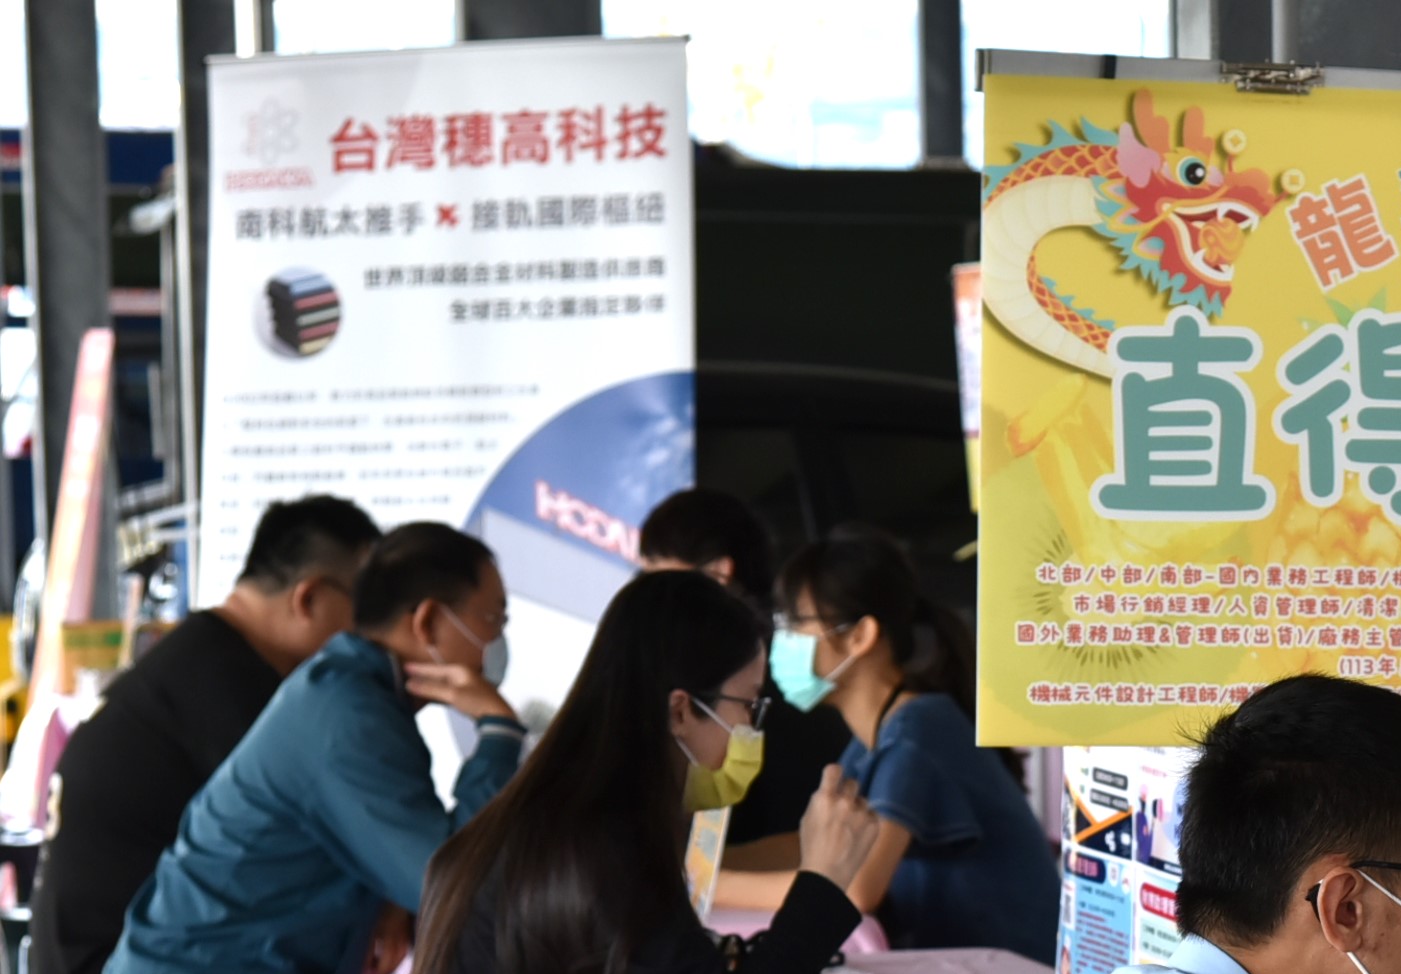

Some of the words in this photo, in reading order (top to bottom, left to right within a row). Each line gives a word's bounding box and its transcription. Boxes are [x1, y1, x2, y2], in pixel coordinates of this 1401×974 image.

[329, 102, 668, 174] 台灣穗高科技
[1287, 174, 1399, 292] 龍
